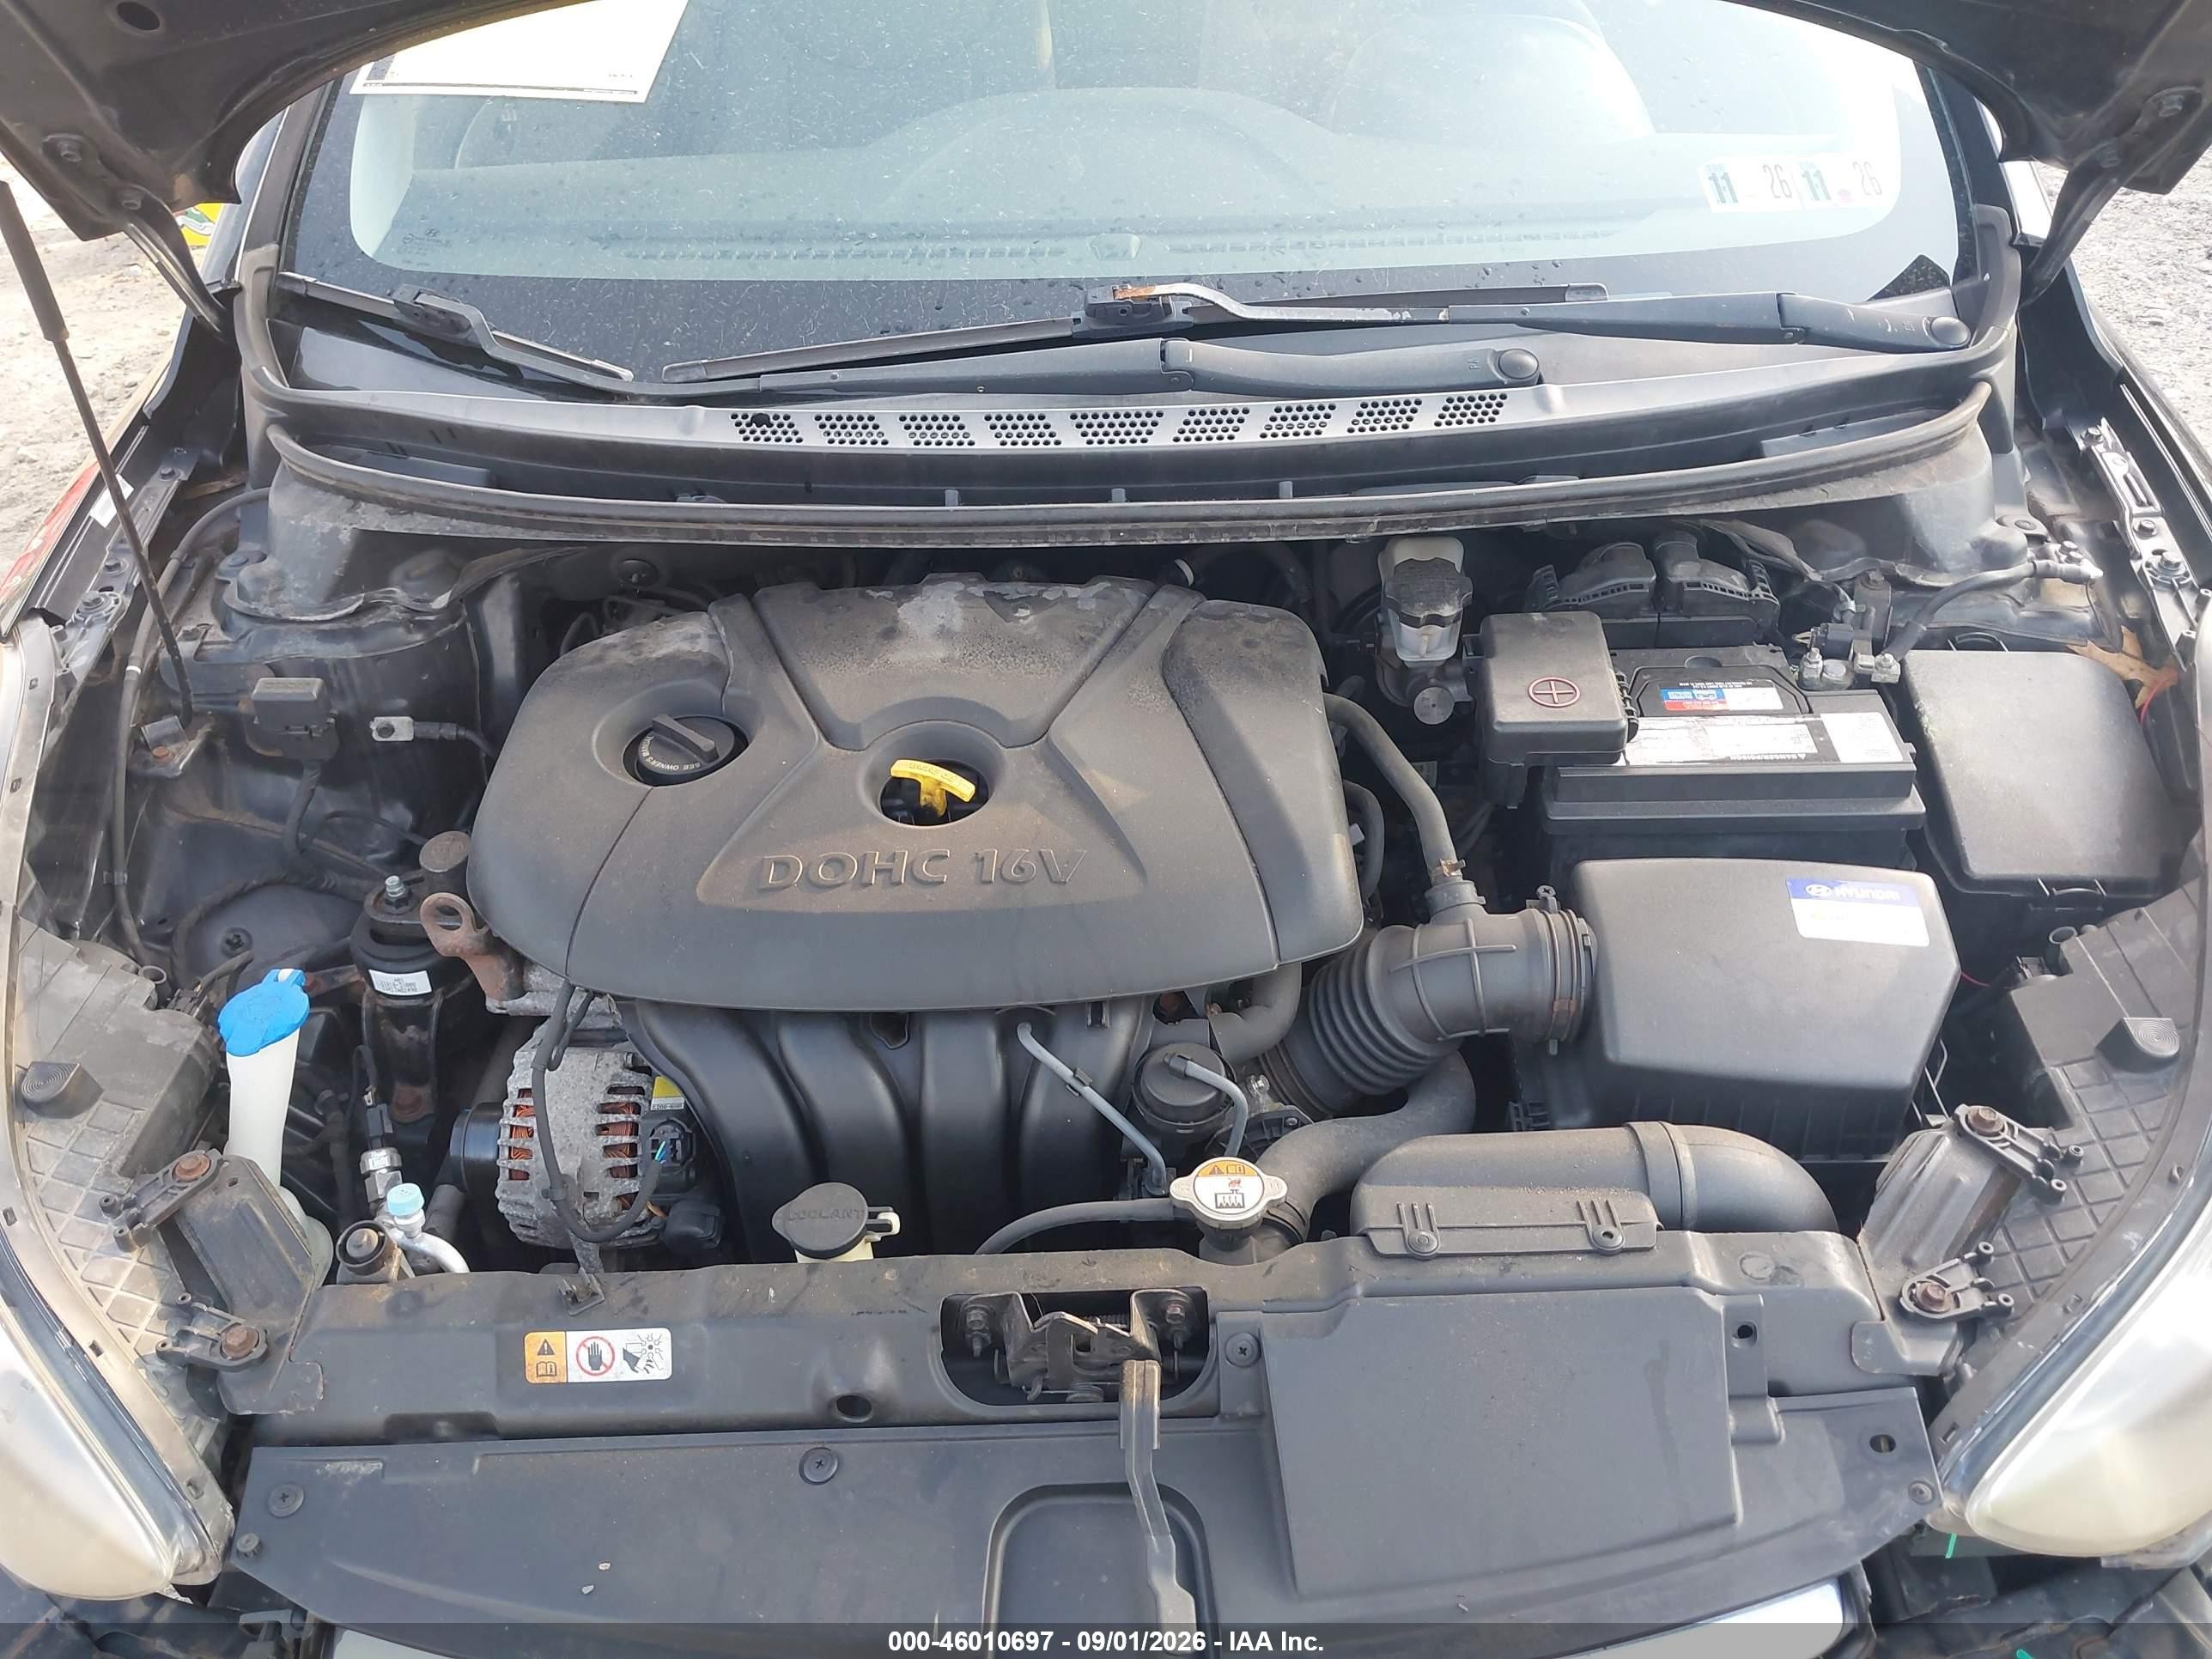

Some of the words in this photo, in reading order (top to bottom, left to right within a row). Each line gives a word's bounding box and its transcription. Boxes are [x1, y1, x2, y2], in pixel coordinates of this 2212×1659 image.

[1708, 173, 1739, 204] 11
[1763, 164, 1792, 198] 26
[1802, 170, 1832, 201] 11
[1853, 161, 1882, 196] 26
[683, 762, 701, 770] SEE
[757, 849, 951, 892] DOHC
[975, 849, 1088, 886] 16V
[787, 1209, 865, 1221] COOLANT
